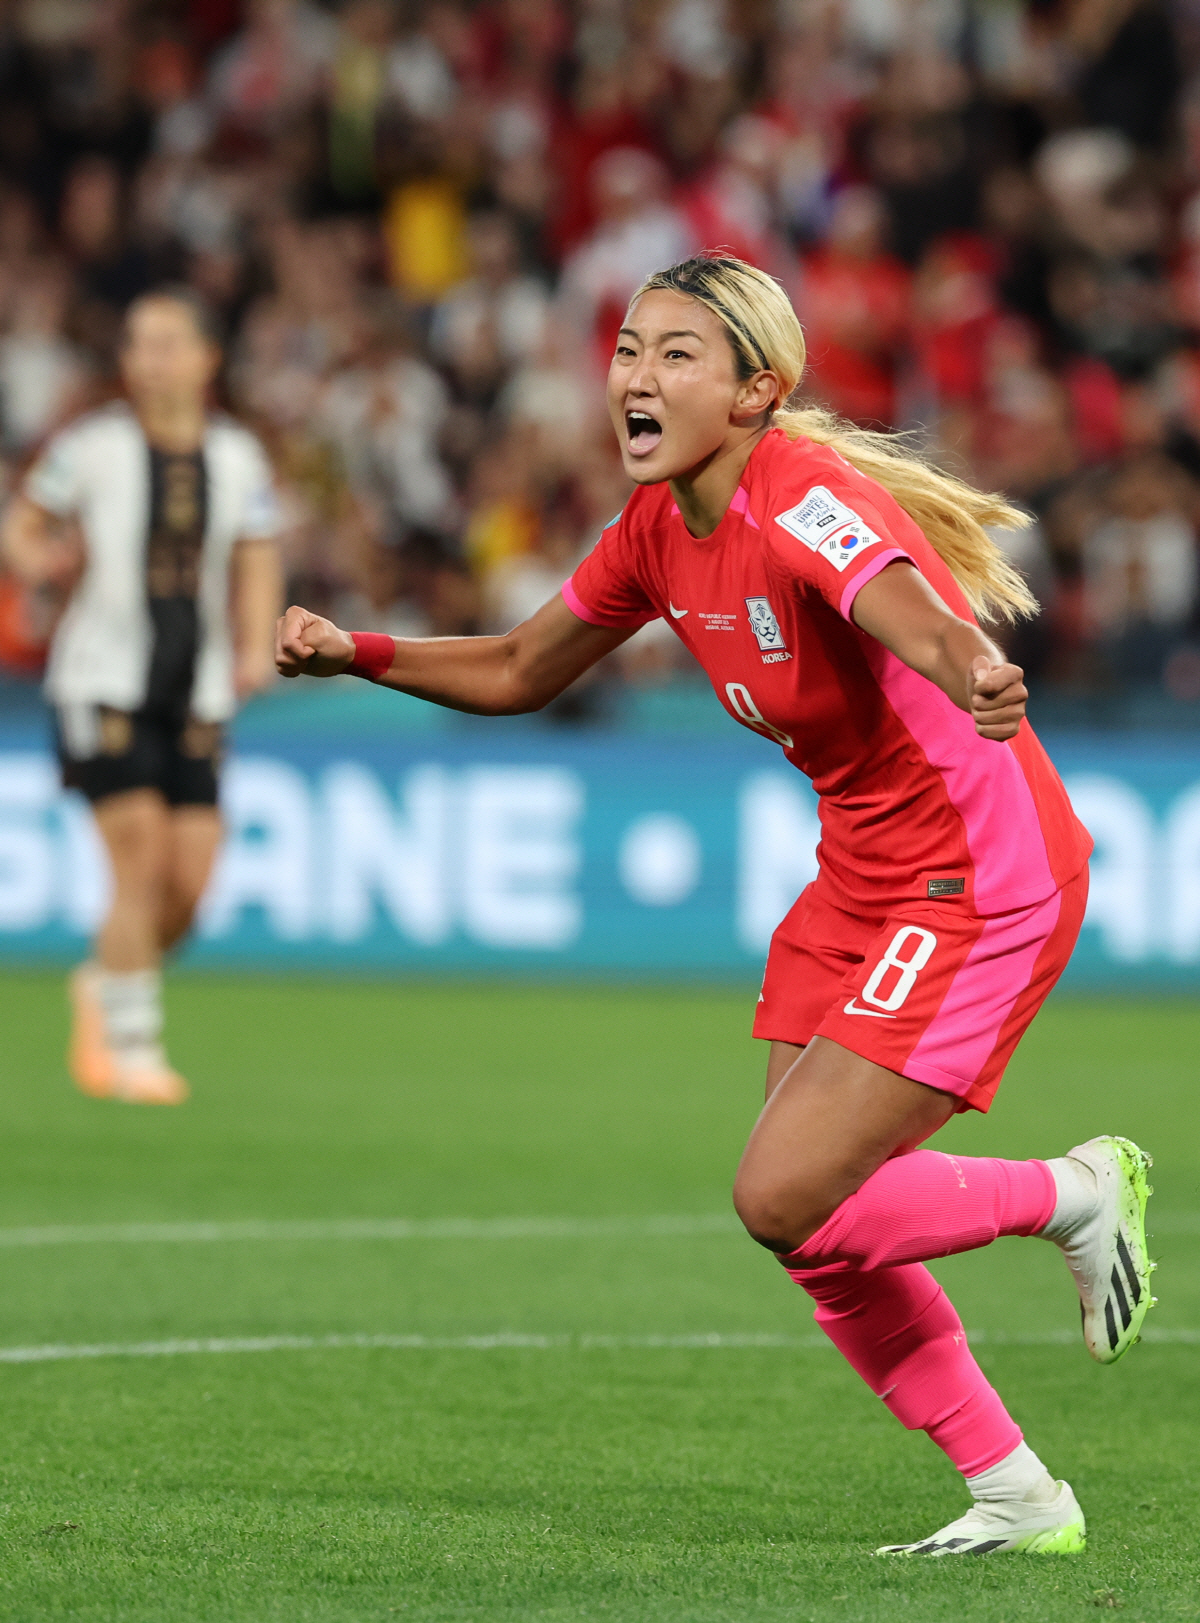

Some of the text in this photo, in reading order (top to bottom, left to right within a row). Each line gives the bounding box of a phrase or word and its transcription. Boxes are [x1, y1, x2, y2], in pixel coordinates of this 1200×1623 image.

[793, 495, 822, 520] FOOTBALL
[797, 500, 829, 524] UNITES
[761, 651, 793, 665] KOREA
[861, 925, 937, 1012] 8
